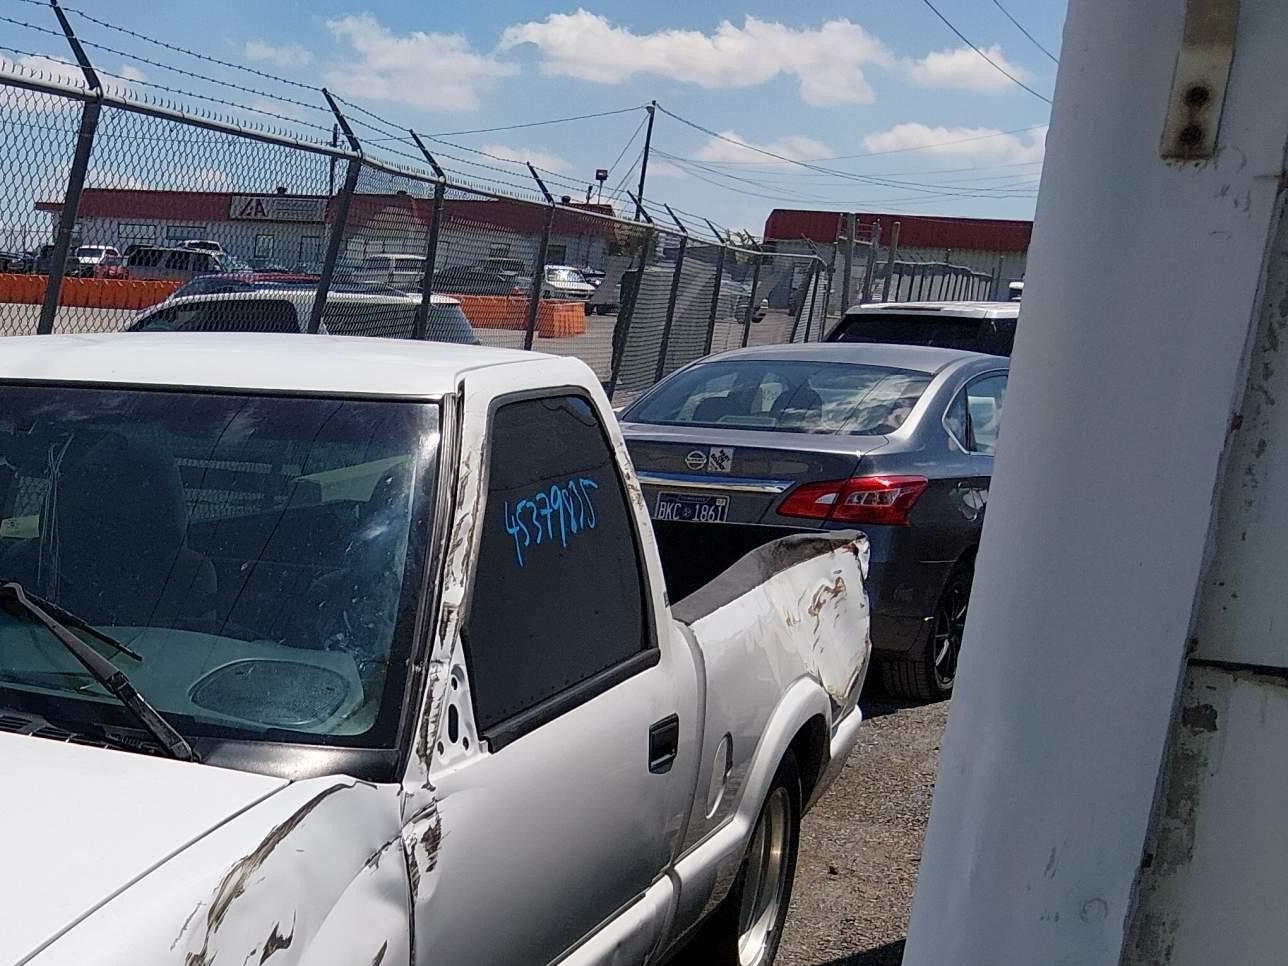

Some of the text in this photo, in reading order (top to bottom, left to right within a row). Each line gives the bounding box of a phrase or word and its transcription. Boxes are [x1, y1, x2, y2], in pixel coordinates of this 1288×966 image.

[504, 478, 599, 568] 45379835
[659, 502, 722, 522] BKC 1861
